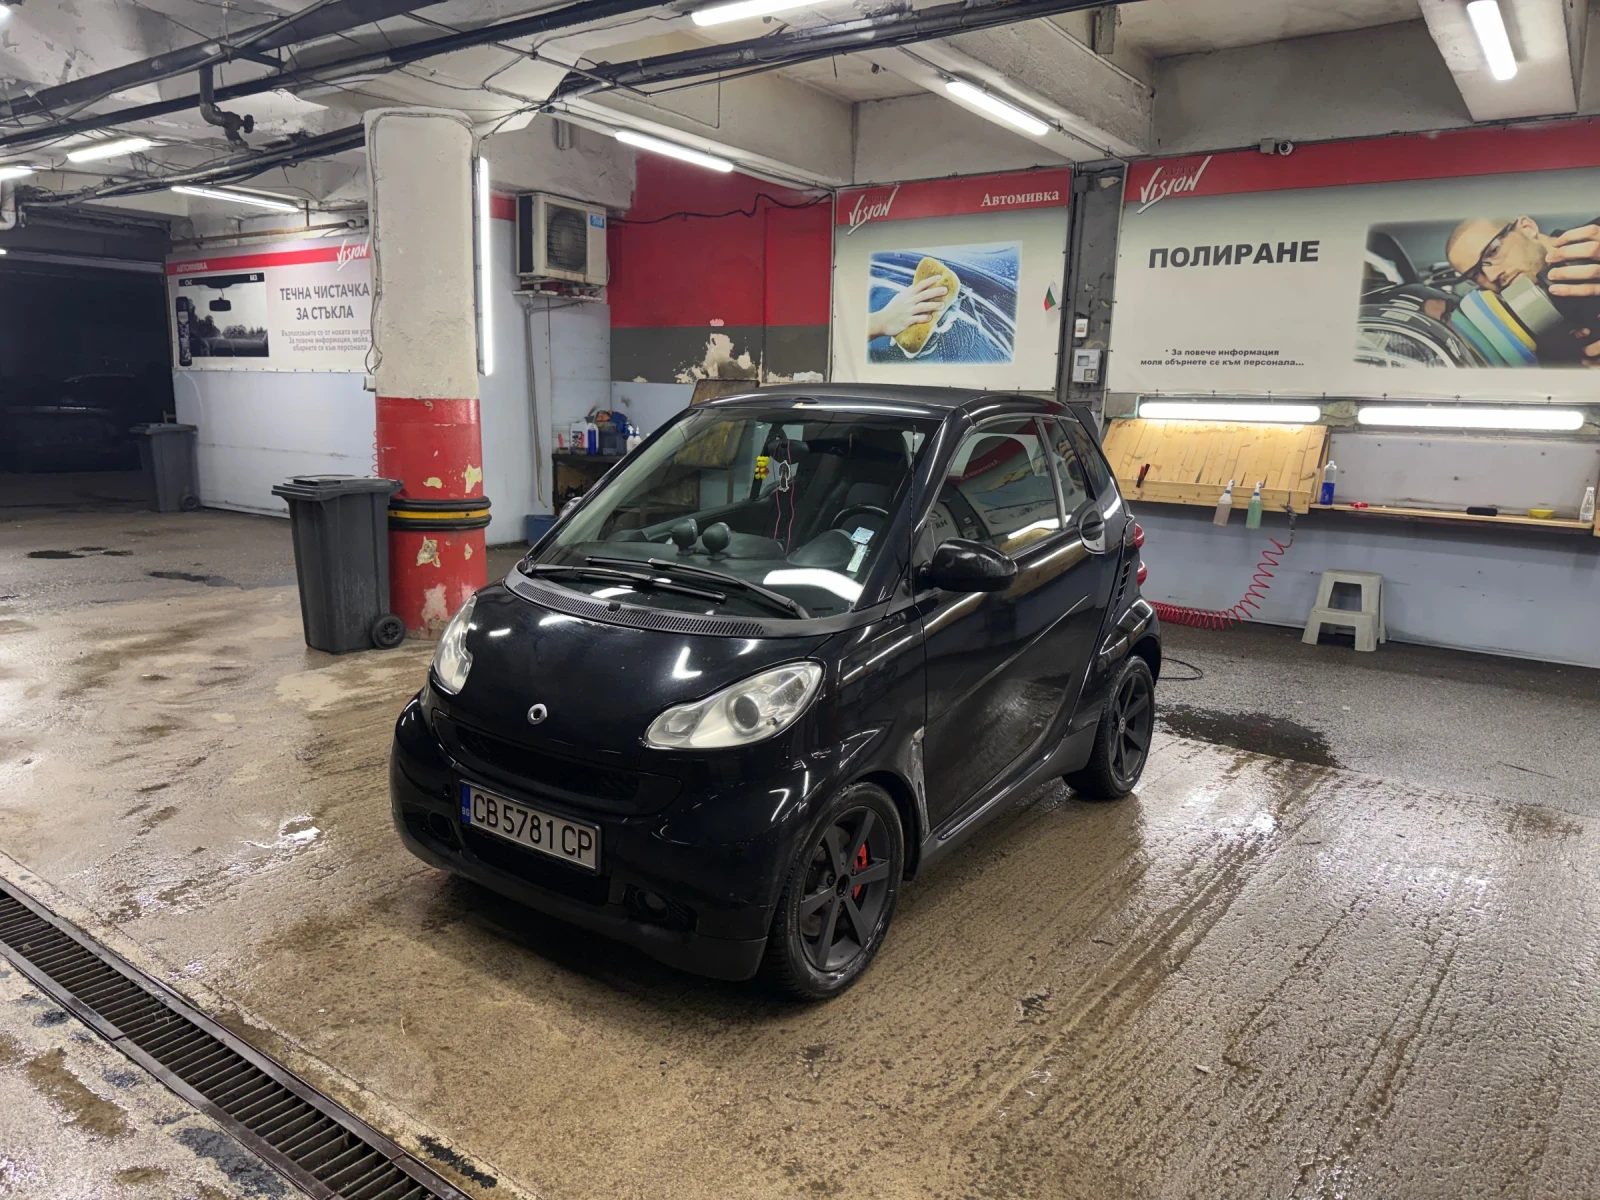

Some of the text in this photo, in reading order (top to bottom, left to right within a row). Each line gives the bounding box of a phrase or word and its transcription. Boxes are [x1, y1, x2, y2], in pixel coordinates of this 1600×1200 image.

[1136, 155, 1213, 215] VISION
[980, 190, 1060, 207] Автомивка
[846, 185, 900, 236] VISION
[336, 234, 371, 272] VISION
[1148, 240, 1320, 269] ПОЛИРАНЕ
[280, 282, 370, 301] ТЕЧНА ЧИСТАЧКА
[296, 305, 354, 321] ЗА СТЪКЛА
[1218, 348, 1279, 357] информация
[1164, 358, 1207, 367] обърнете
[461, 806, 470, 817] BG
